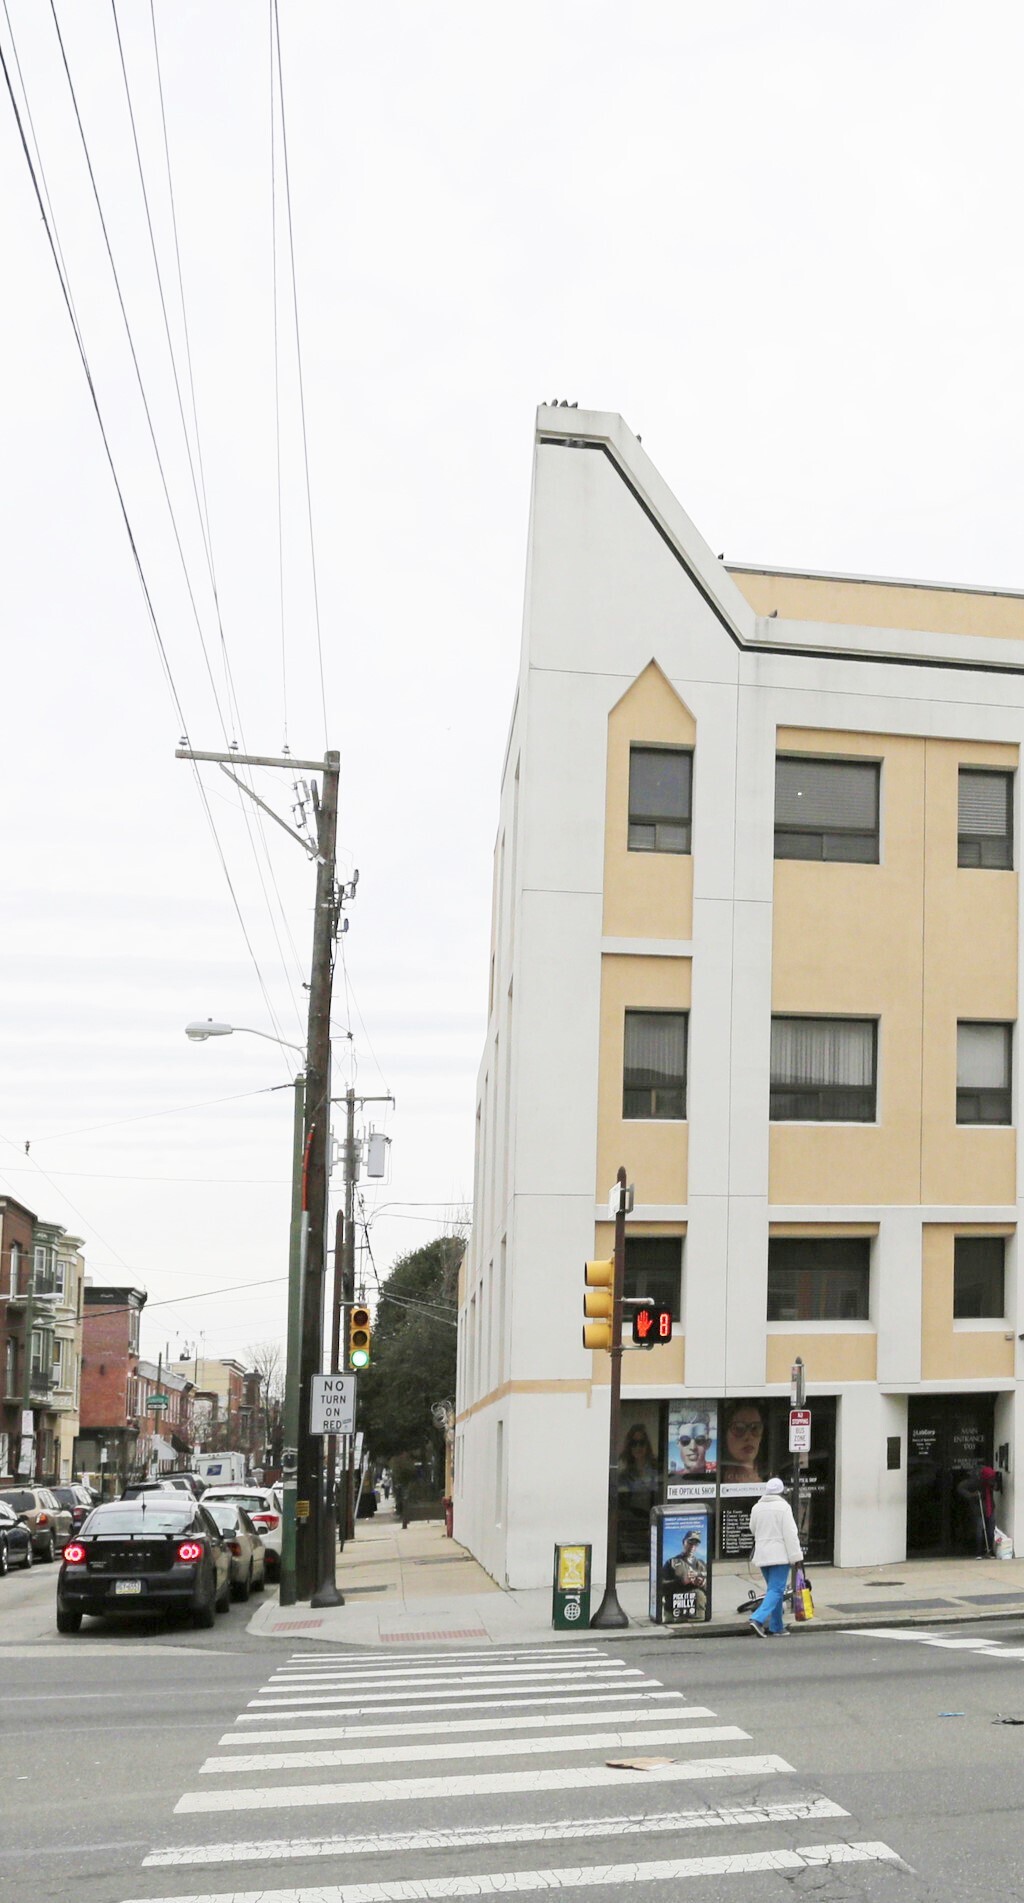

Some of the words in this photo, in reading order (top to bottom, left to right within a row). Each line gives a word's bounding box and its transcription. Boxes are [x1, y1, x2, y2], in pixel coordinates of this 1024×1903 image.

[660, 1313, 668, 1337] 8
[324, 1380, 344, 1392] NO
[321, 1395, 346, 1404] TURN
[325, 1407, 340, 1417] ON
[323, 1420, 342, 1430] RED
[668, 1487, 678, 1496] THE
[680, 1487, 700, 1496] OPTICAL
[702, 1486, 715, 1495] SHOP
